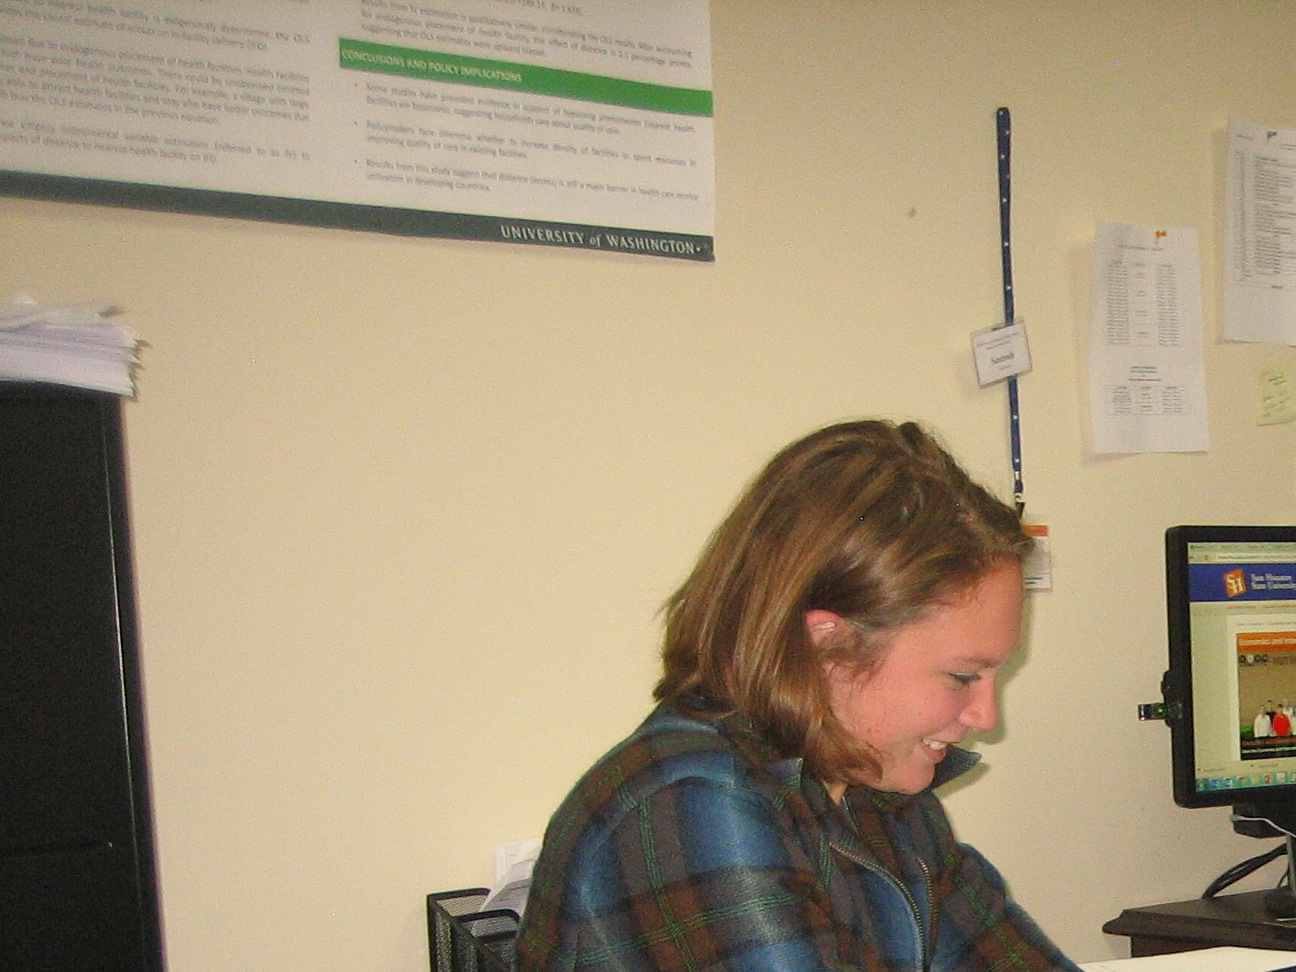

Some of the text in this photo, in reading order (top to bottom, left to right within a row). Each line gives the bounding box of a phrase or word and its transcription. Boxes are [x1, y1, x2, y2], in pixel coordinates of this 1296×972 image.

[342, 48, 521, 82] CONCLUSIONS AND POLICY IMPLICATIONS
[500, 225, 695, 255] UNIVERSITY of WASHINGTON
